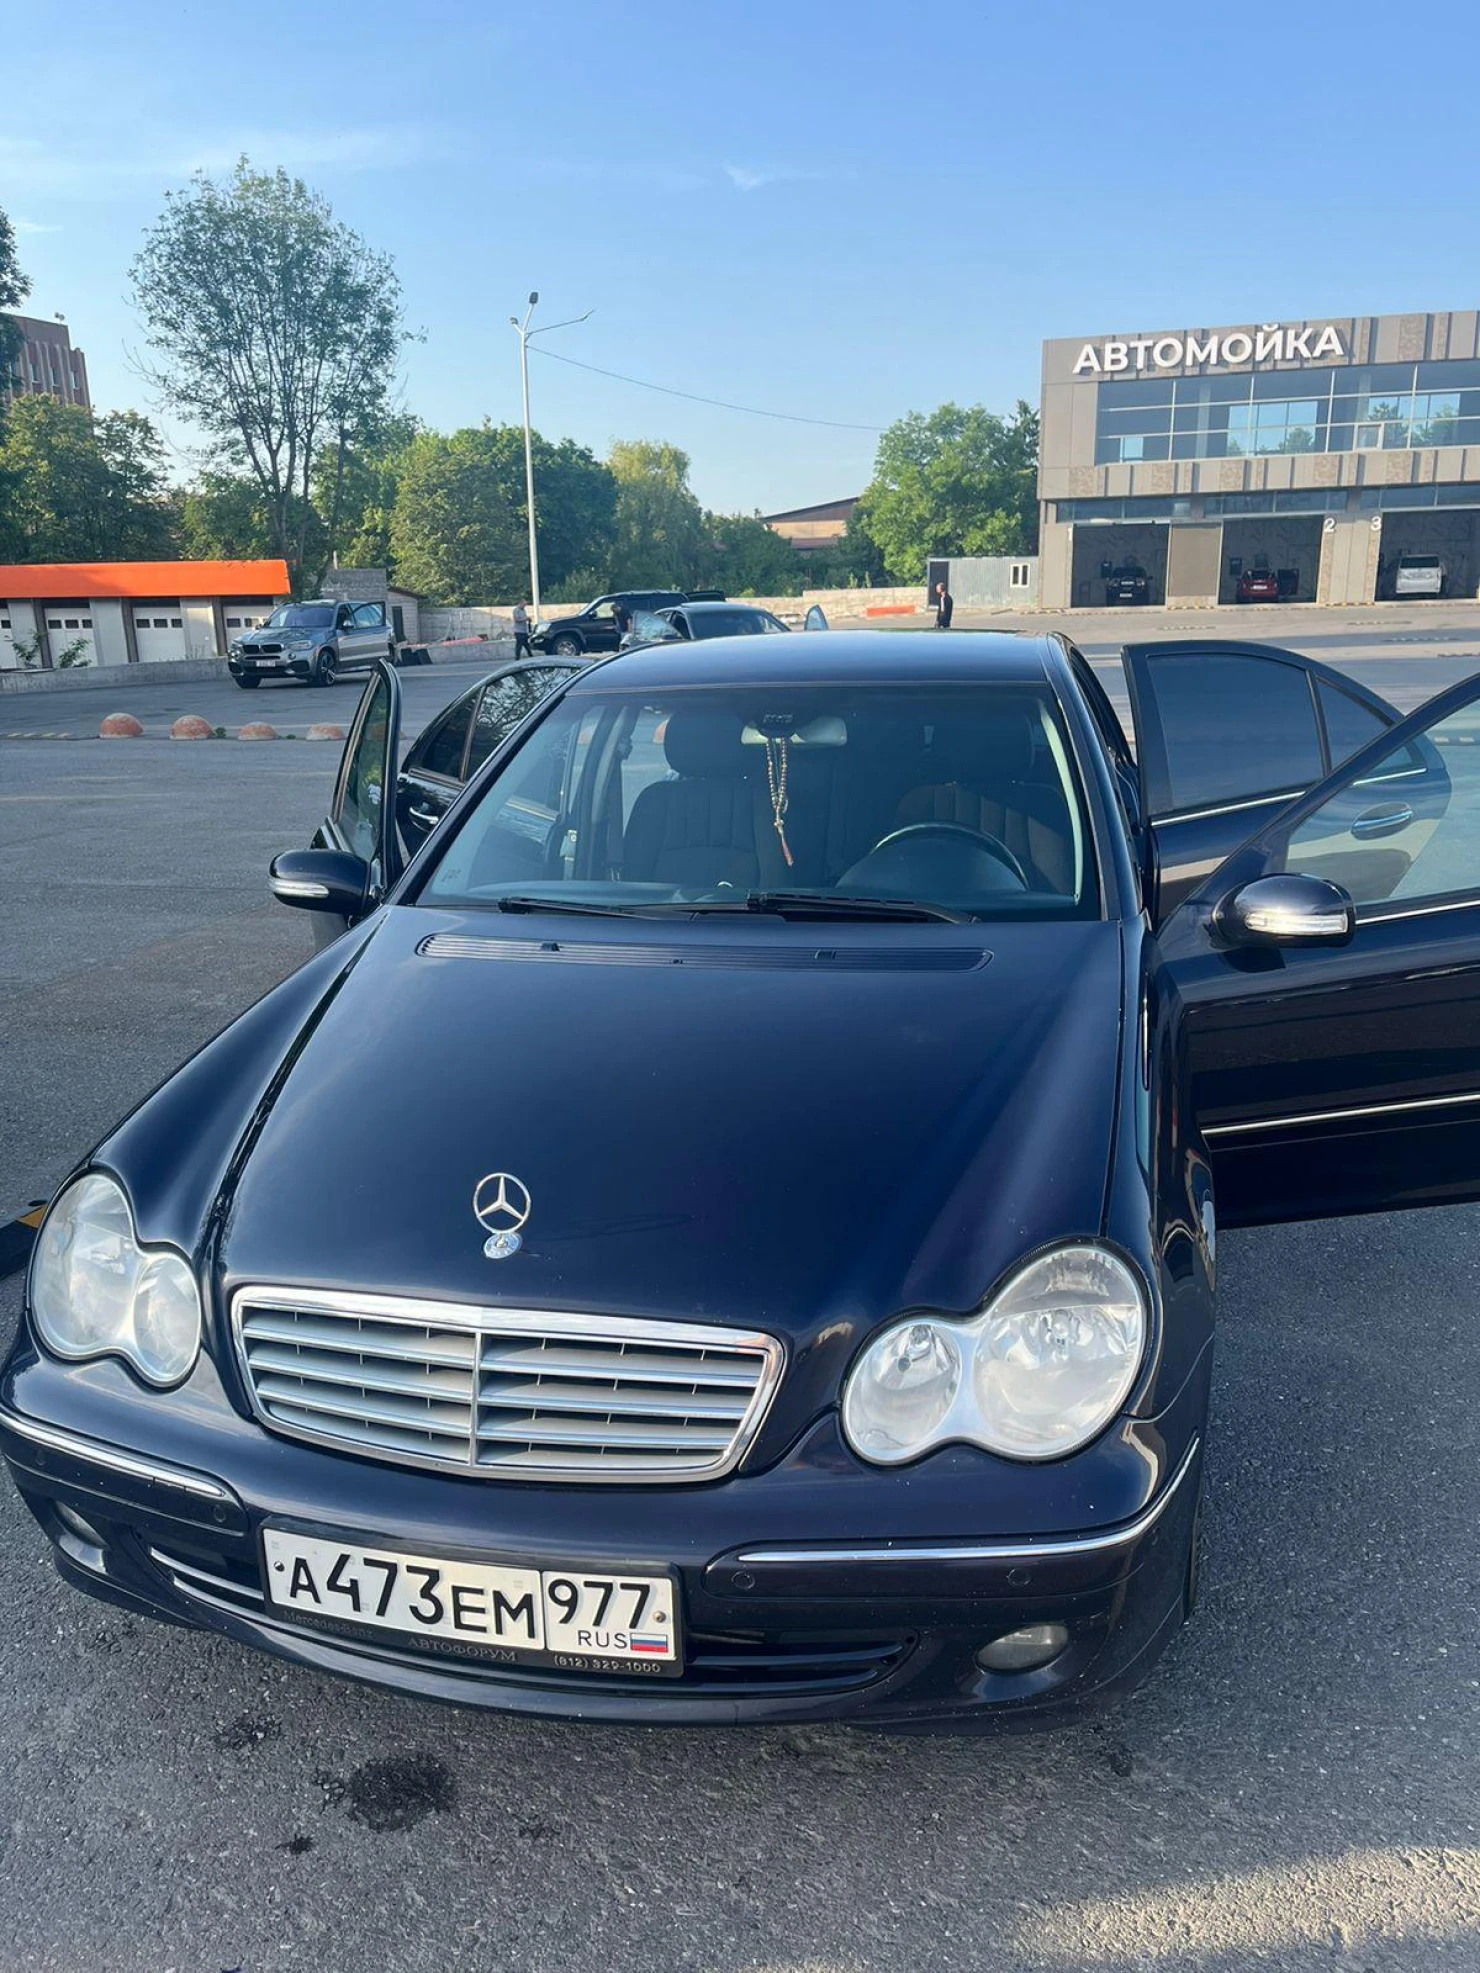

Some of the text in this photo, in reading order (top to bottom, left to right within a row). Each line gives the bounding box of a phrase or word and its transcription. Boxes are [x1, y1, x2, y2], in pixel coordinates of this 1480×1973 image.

[1072, 323, 1344, 374] АВТОМОЙКА
[1323, 518, 1336, 532] 2
[1370, 516, 1382, 531] 3
[548, 1579, 651, 1629] 977
[408, 1637, 517, 1662] АВТОФОРУМ
[577, 1629, 628, 1649] RUS
